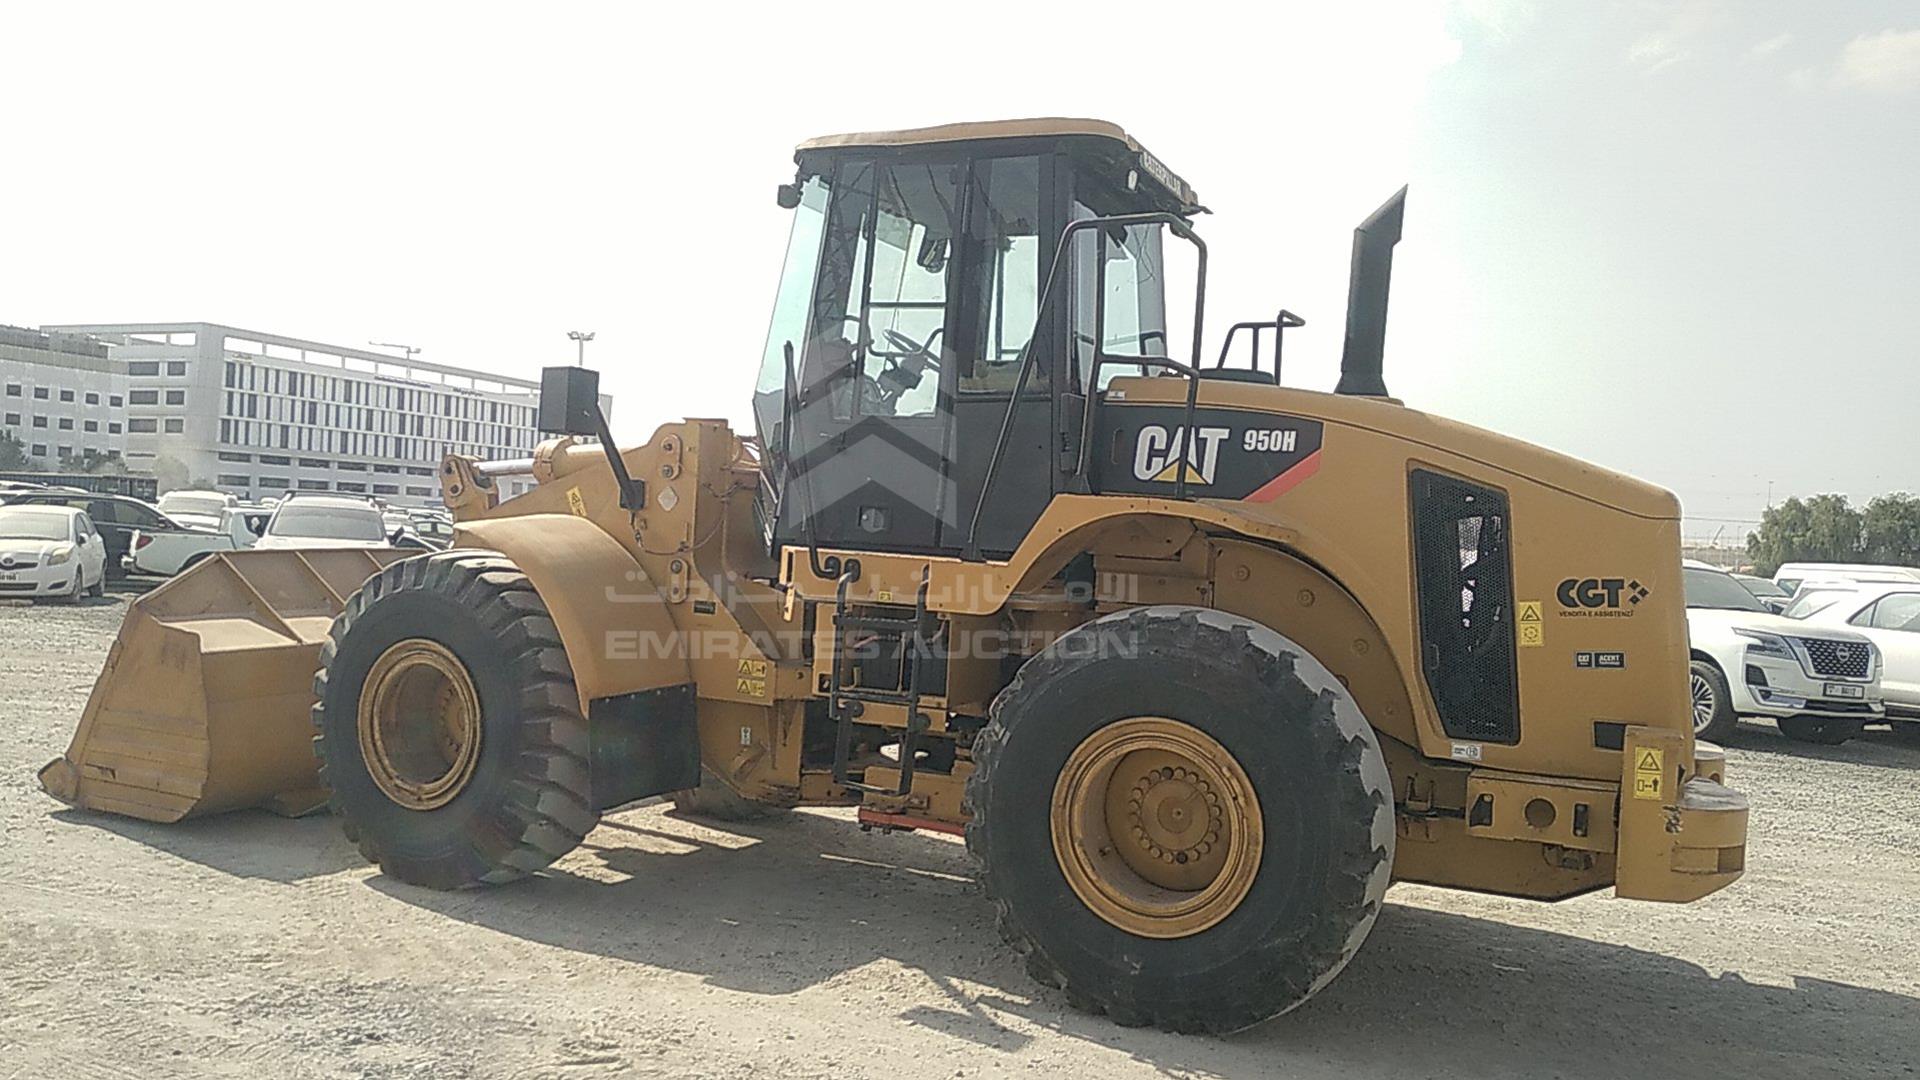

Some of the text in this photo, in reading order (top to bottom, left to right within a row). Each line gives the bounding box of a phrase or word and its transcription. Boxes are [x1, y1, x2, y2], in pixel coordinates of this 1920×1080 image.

[1135, 425, 1297, 484] CAT 950H
[1557, 579, 1624, 608] CGT
